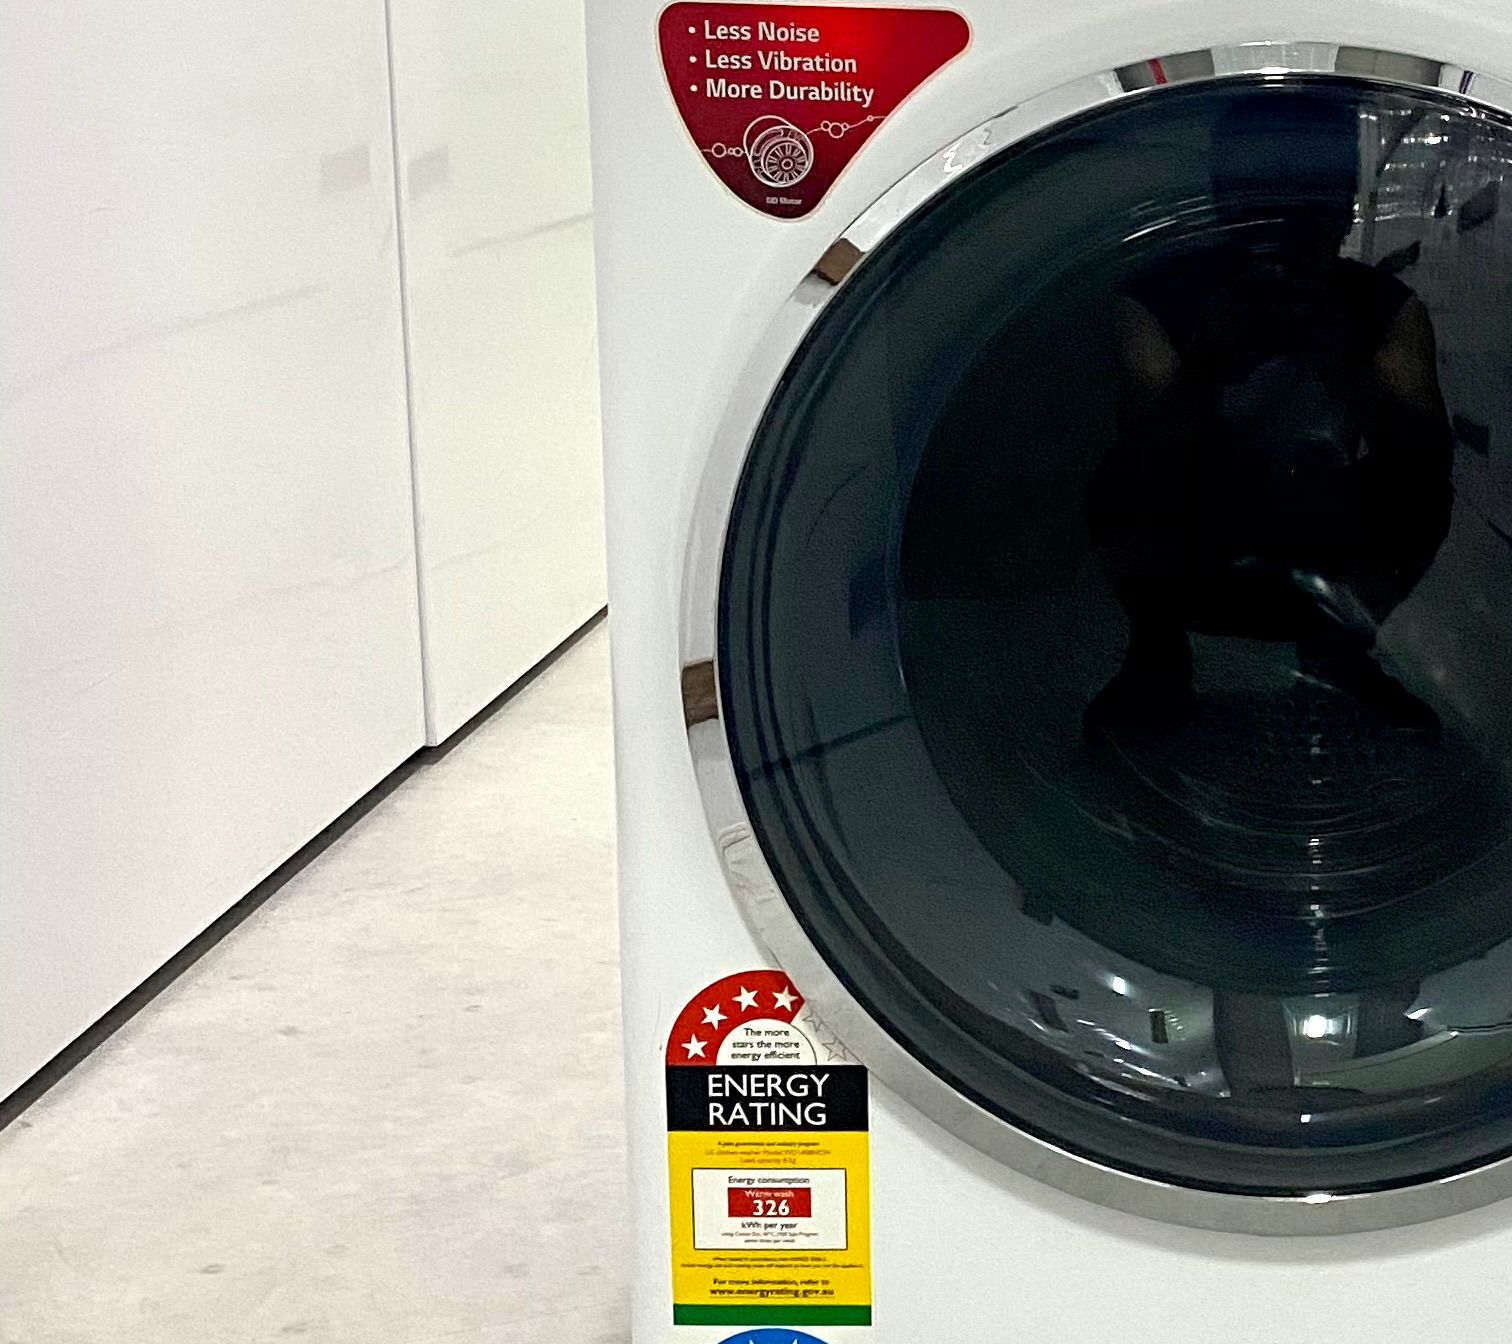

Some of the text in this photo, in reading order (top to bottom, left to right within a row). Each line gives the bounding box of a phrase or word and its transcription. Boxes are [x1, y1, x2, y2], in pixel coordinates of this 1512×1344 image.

[704, 20, 820, 43] Less Noise
[705, 49, 857, 73] Less Vibration
[705, 78, 874, 108] More Durability
[743, 1027, 762, 1036] The
[757, 1040, 772, 1048] the
[731, 1051, 800, 1061] energy efficient
[707, 1073, 830, 1098] ENERGY
[708, 1101, 828, 1126] RATING
[728, 1175, 810, 1185] Energy consumption
[752, 1199, 790, 1216] 326
[763, 1222, 778, 1231] per
[780, 1223, 798, 1231] year
